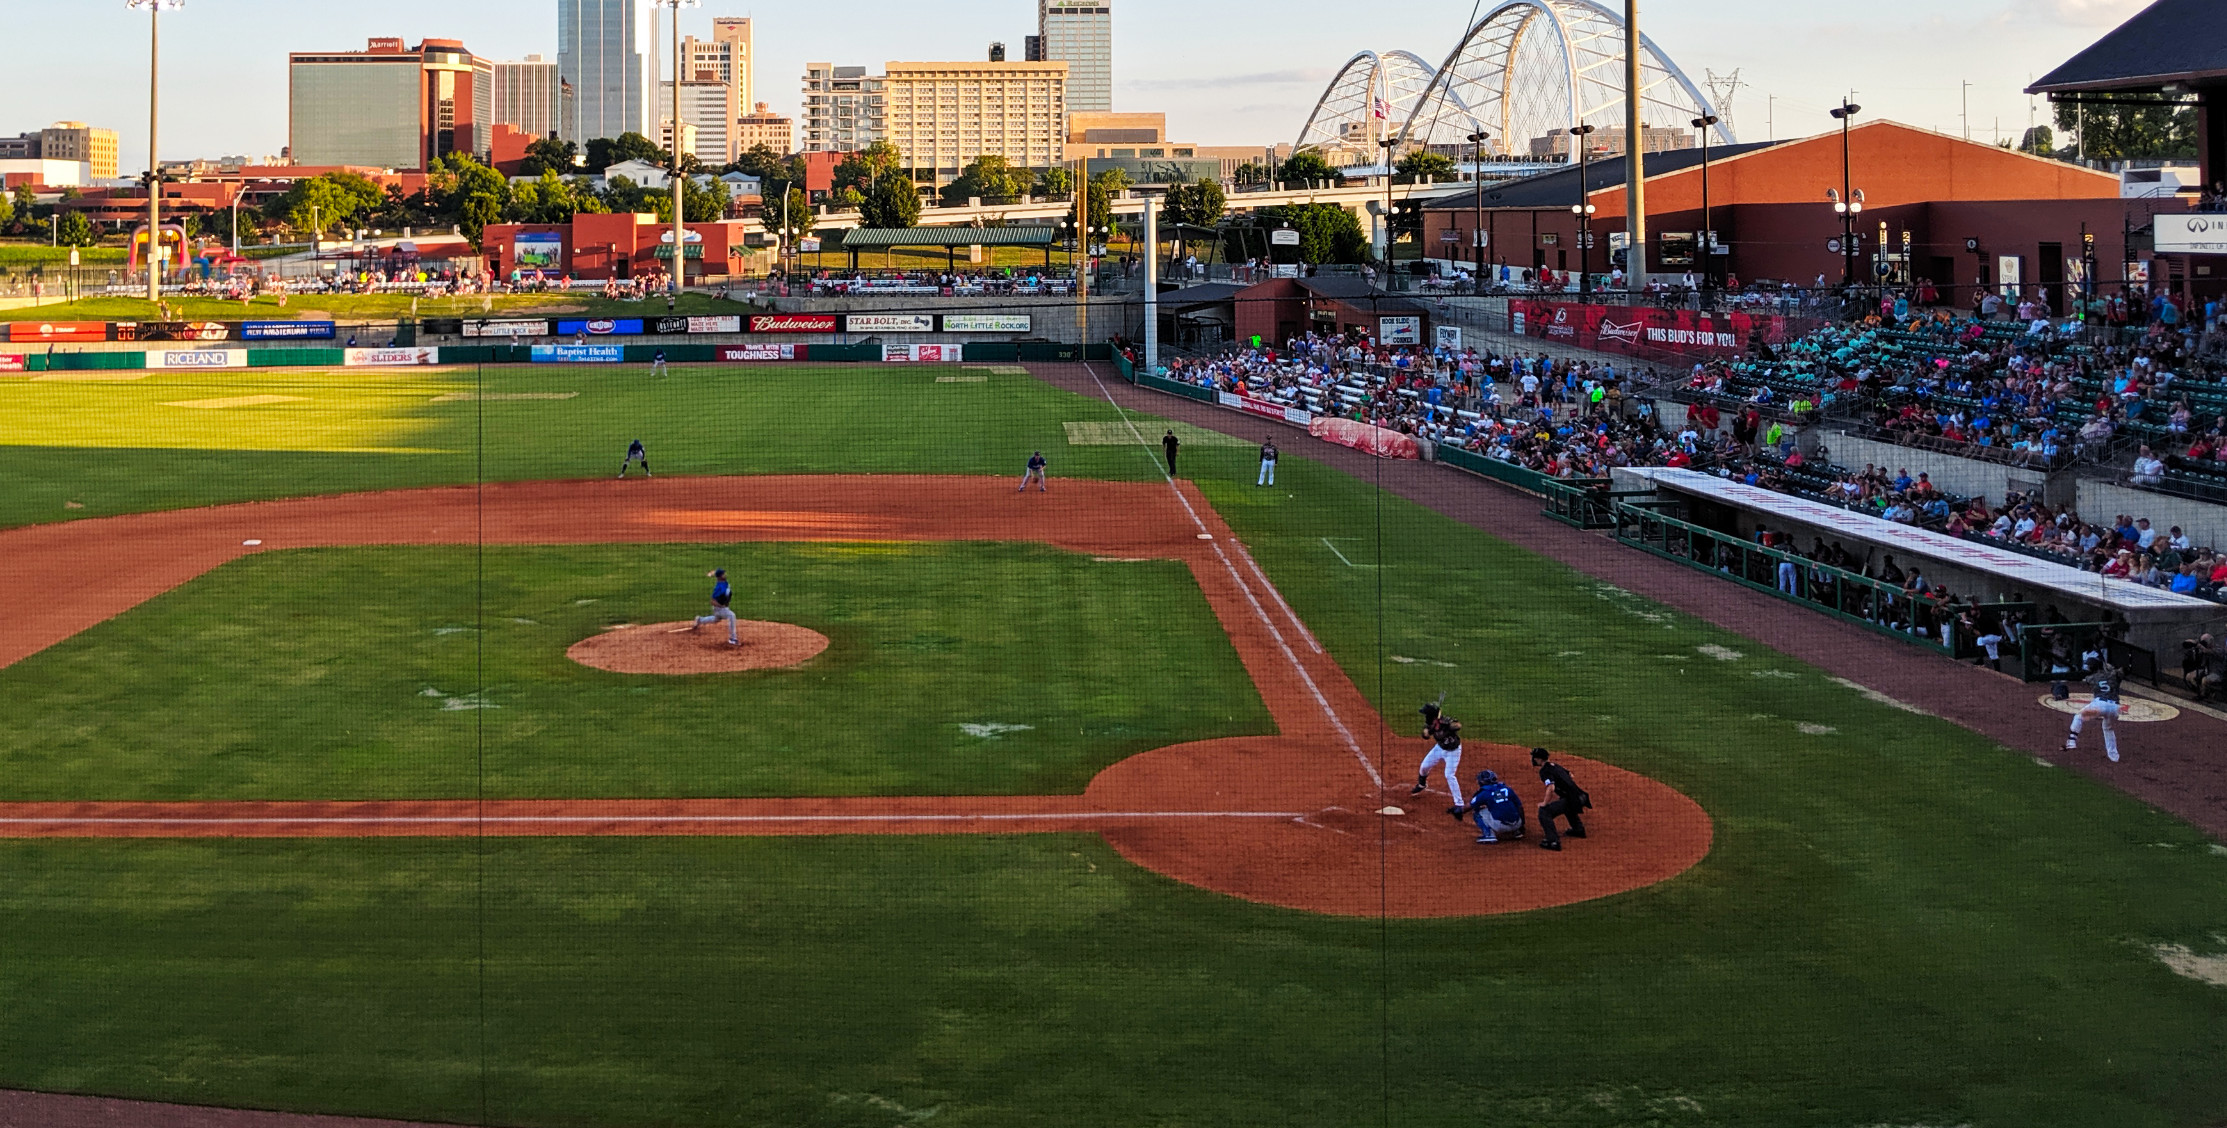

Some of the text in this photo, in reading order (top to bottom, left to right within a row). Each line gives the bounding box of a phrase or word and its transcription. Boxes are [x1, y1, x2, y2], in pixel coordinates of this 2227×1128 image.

[369, 41, 398, 49] Marriott
[753, 316, 834, 330] Budweiser
[849, 317, 872, 325] STAR
[874, 317, 898, 325] BOLT,
[945, 320, 969, 329] NORTH
[995, 321, 1029, 329] ROCK.ORG
[1603, 325, 1638, 336] Budweiser
[1647, 328, 1738, 347] THIS BUD'S FOR YOU.
[556, 347, 618, 357] Baptist Health
[725, 351, 780, 360] TOUGHNESS
[167, 353, 225, 364] RICELAND
[371, 354, 412, 362] SLIDERS
[2098, 681, 2110, 692] 5
